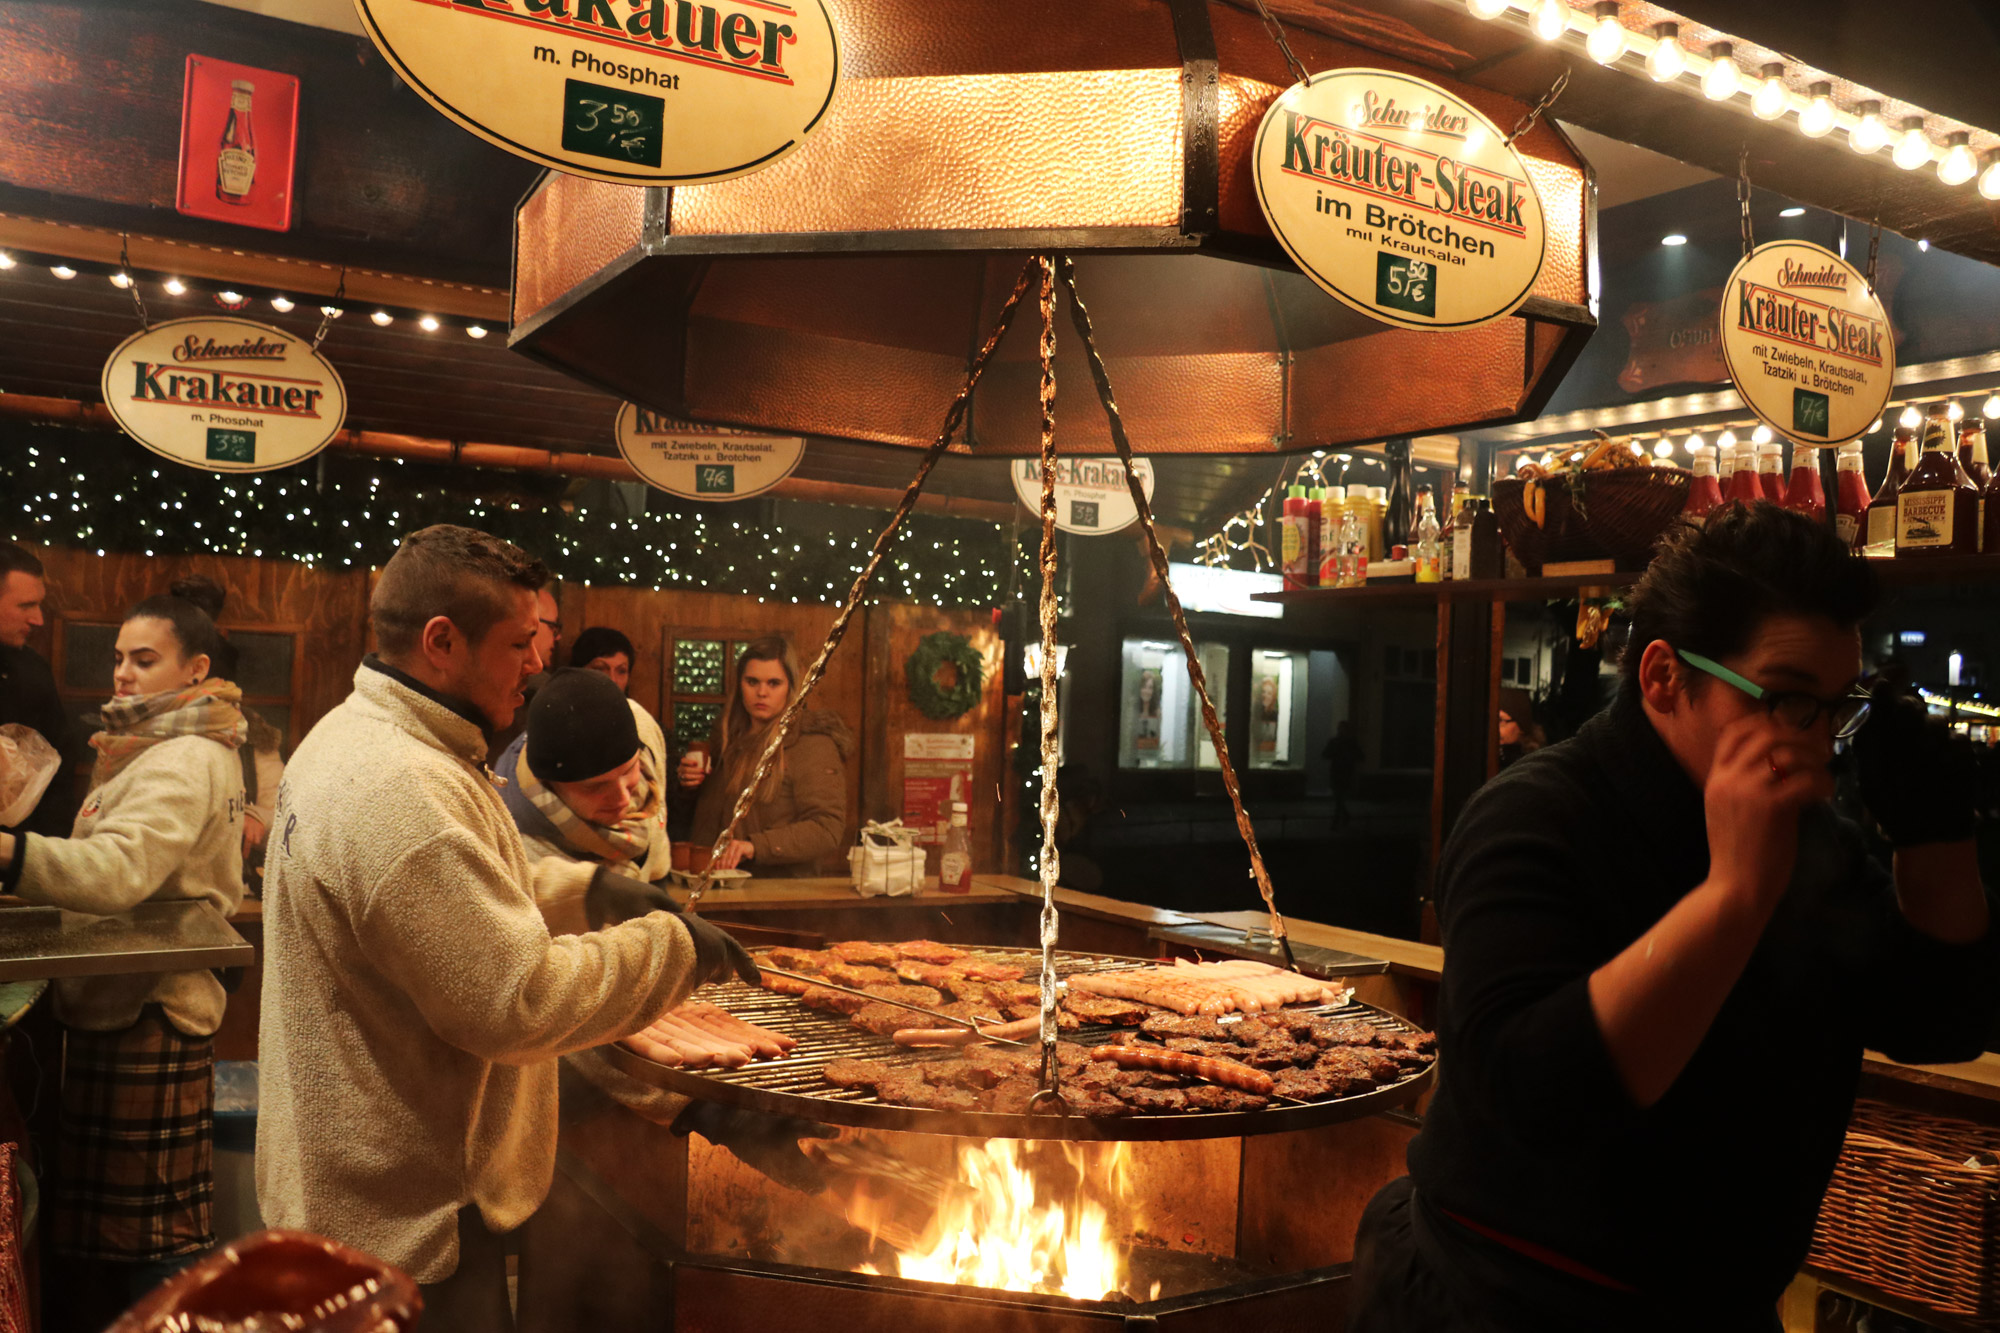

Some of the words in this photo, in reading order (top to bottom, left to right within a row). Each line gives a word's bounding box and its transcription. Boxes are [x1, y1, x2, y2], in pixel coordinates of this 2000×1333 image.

[438, 0, 797, 69] auer
[533, 44, 560, 67] m.
[571, 53, 679, 91] Phosphat
[576, 99, 608, 131] 3
[1352, 89, 1469, 134] Schnders
[1281, 109, 1526, 229] Kräuter-Steak
[1316, 190, 1351, 220] im
[1365, 202, 1495, 258] Brötchen
[1387, 265, 1406, 295] 5
[1777, 257, 1848, 288] Schneiders
[1738, 278, 1883, 359] Kräuter-Steak
[172, 334, 287, 363] Schneiders
[1752, 345, 1768, 359] mit
[1771, 346, 1817, 372] Zwiebeln,
[131, 361, 324, 414] Krakauer
[1762, 361, 1797, 382] Tzatziki
[1801, 375, 1810, 385] u.
[1813, 375, 1854, 396] Brötchen
[191, 413, 205, 423] m.
[209, 413, 264, 428] Phosphat
[651, 441, 667, 450] mit
[663, 451, 699, 461] Tzatziki
[1024, 458, 1147, 487] Ke-Krakar
[1904, 495, 1946, 507] MISSISSIPPI
[1904, 505, 1946, 517] BARBECUE
